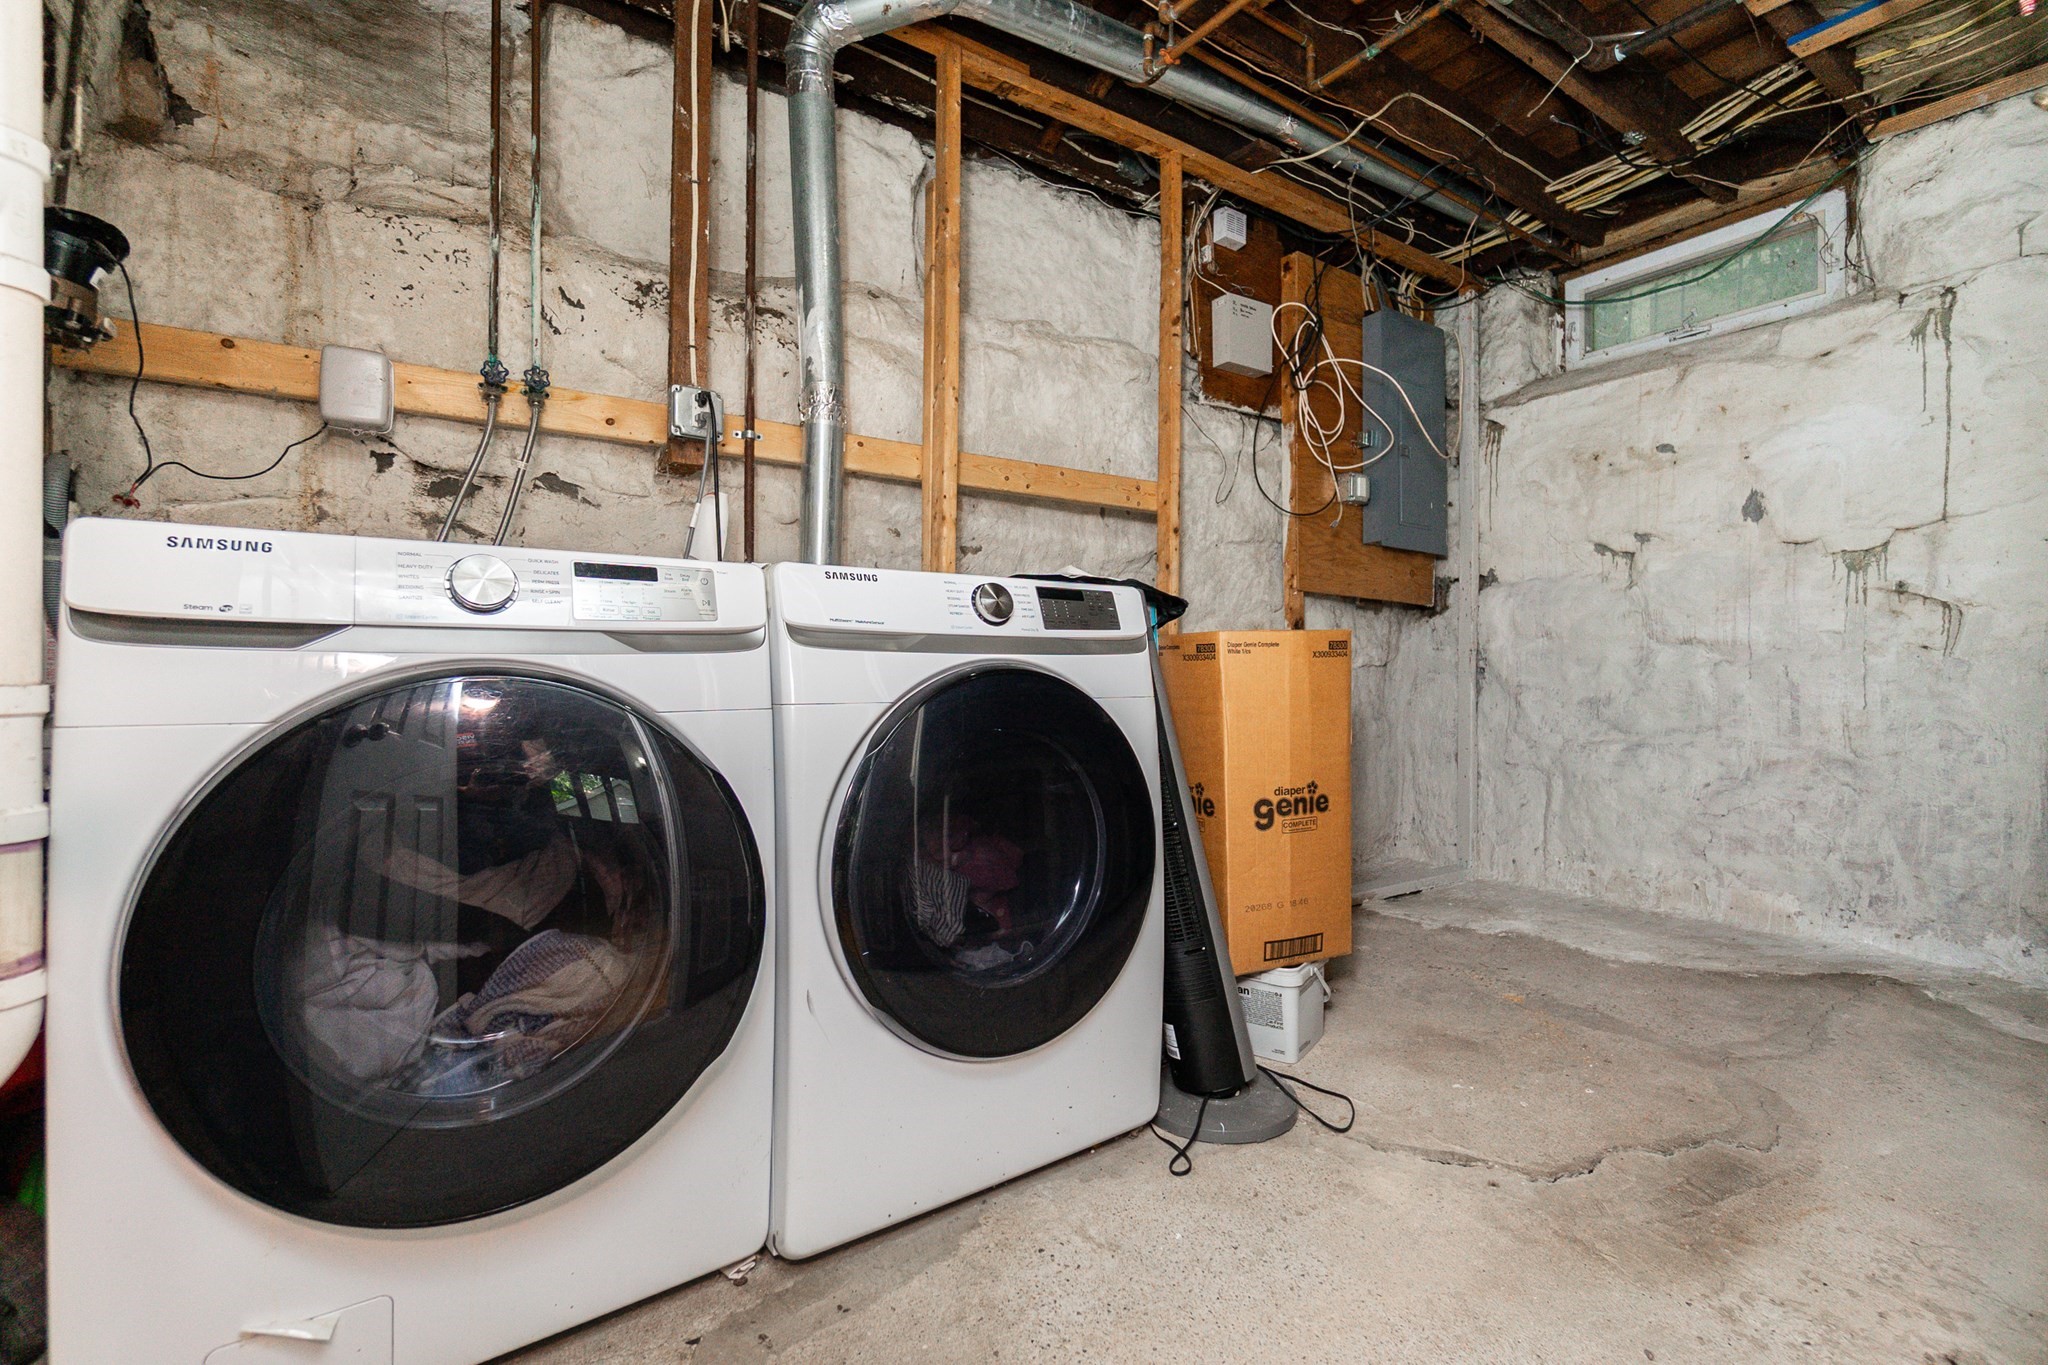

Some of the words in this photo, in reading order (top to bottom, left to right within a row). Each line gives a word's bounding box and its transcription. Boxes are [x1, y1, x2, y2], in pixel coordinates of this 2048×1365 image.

[166, 535, 273, 553] SAMSUNG
[824, 571, 879, 583] SAMSUNG
[183, 603, 213, 611] Steam
[1196, 643, 1216, 653] 78300
[1328, 641, 1348, 650] 78300
[1312, 650, 1348, 658] X300933404
[1274, 786, 1306, 797] diaper
[1253, 793, 1329, 831] genie
[1283, 818, 1316, 829] COMPLETE
[1245, 903, 1272, 912] 20268
[1276, 901, 1285, 909] G
